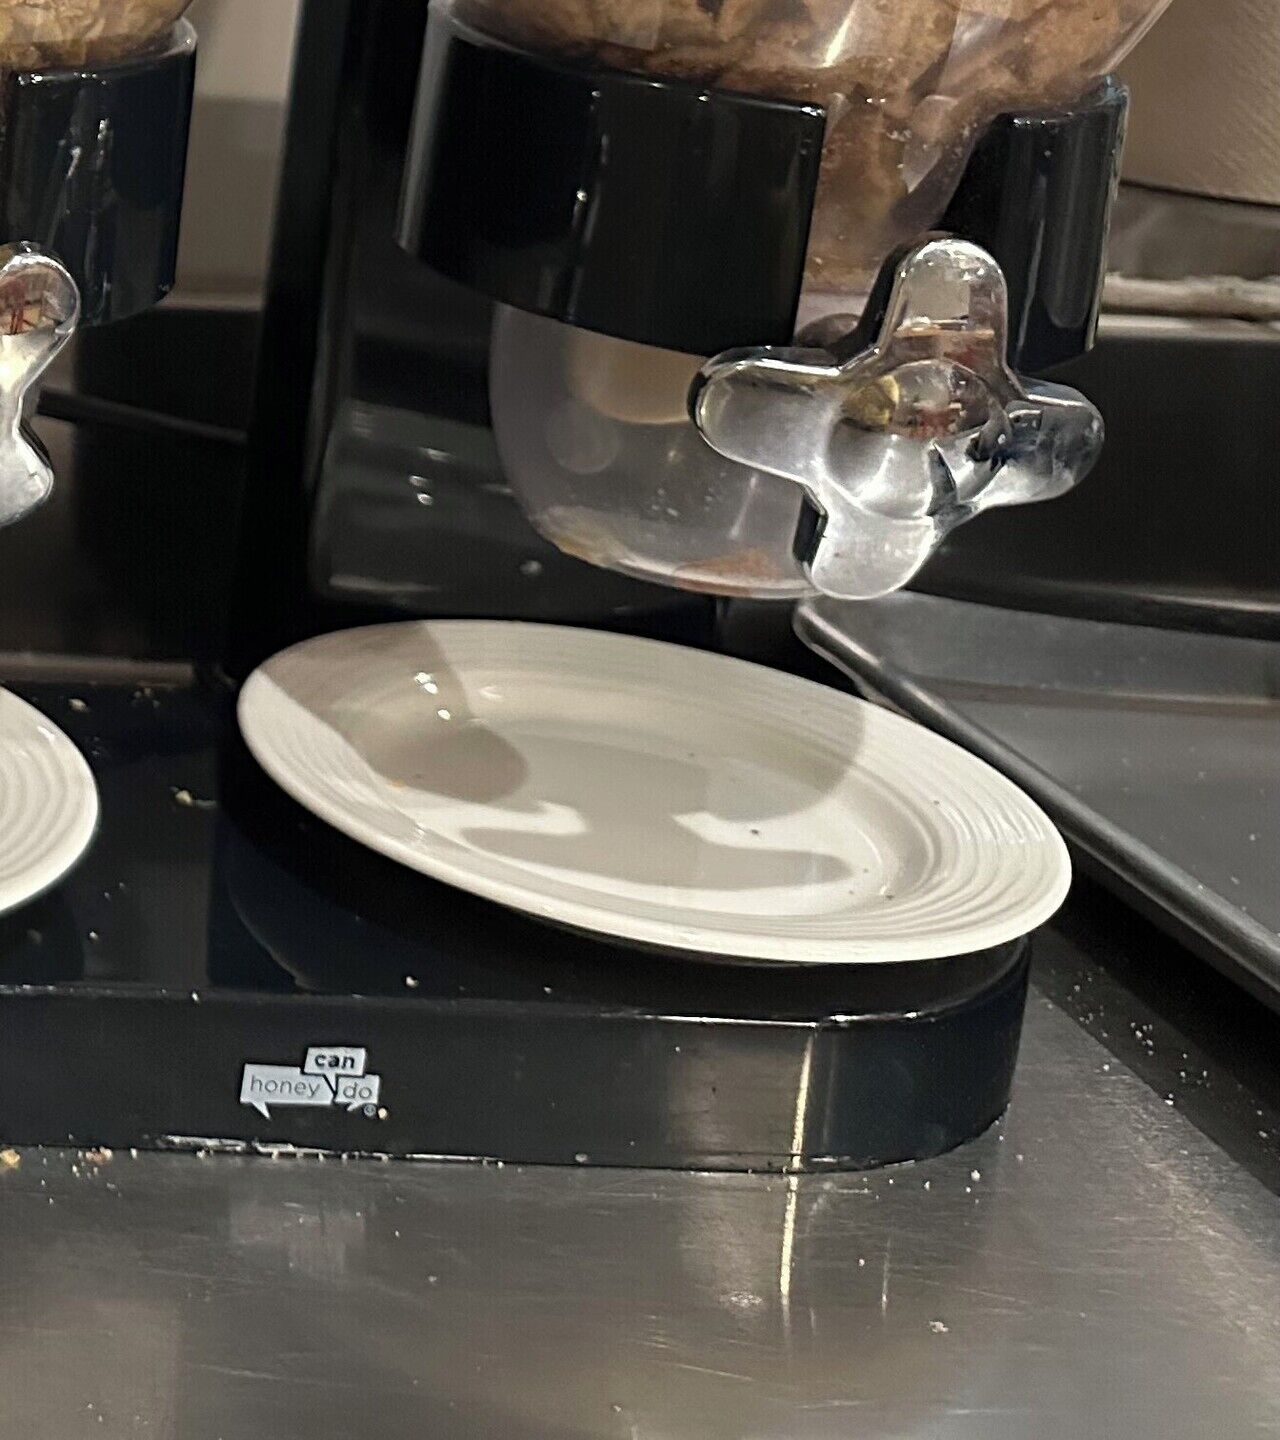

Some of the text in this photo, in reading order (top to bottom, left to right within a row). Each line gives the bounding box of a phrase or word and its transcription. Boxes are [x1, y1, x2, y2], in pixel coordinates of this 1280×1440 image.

[314, 1053, 356, 1070] can
[249, 1074, 373, 1100] honey do
